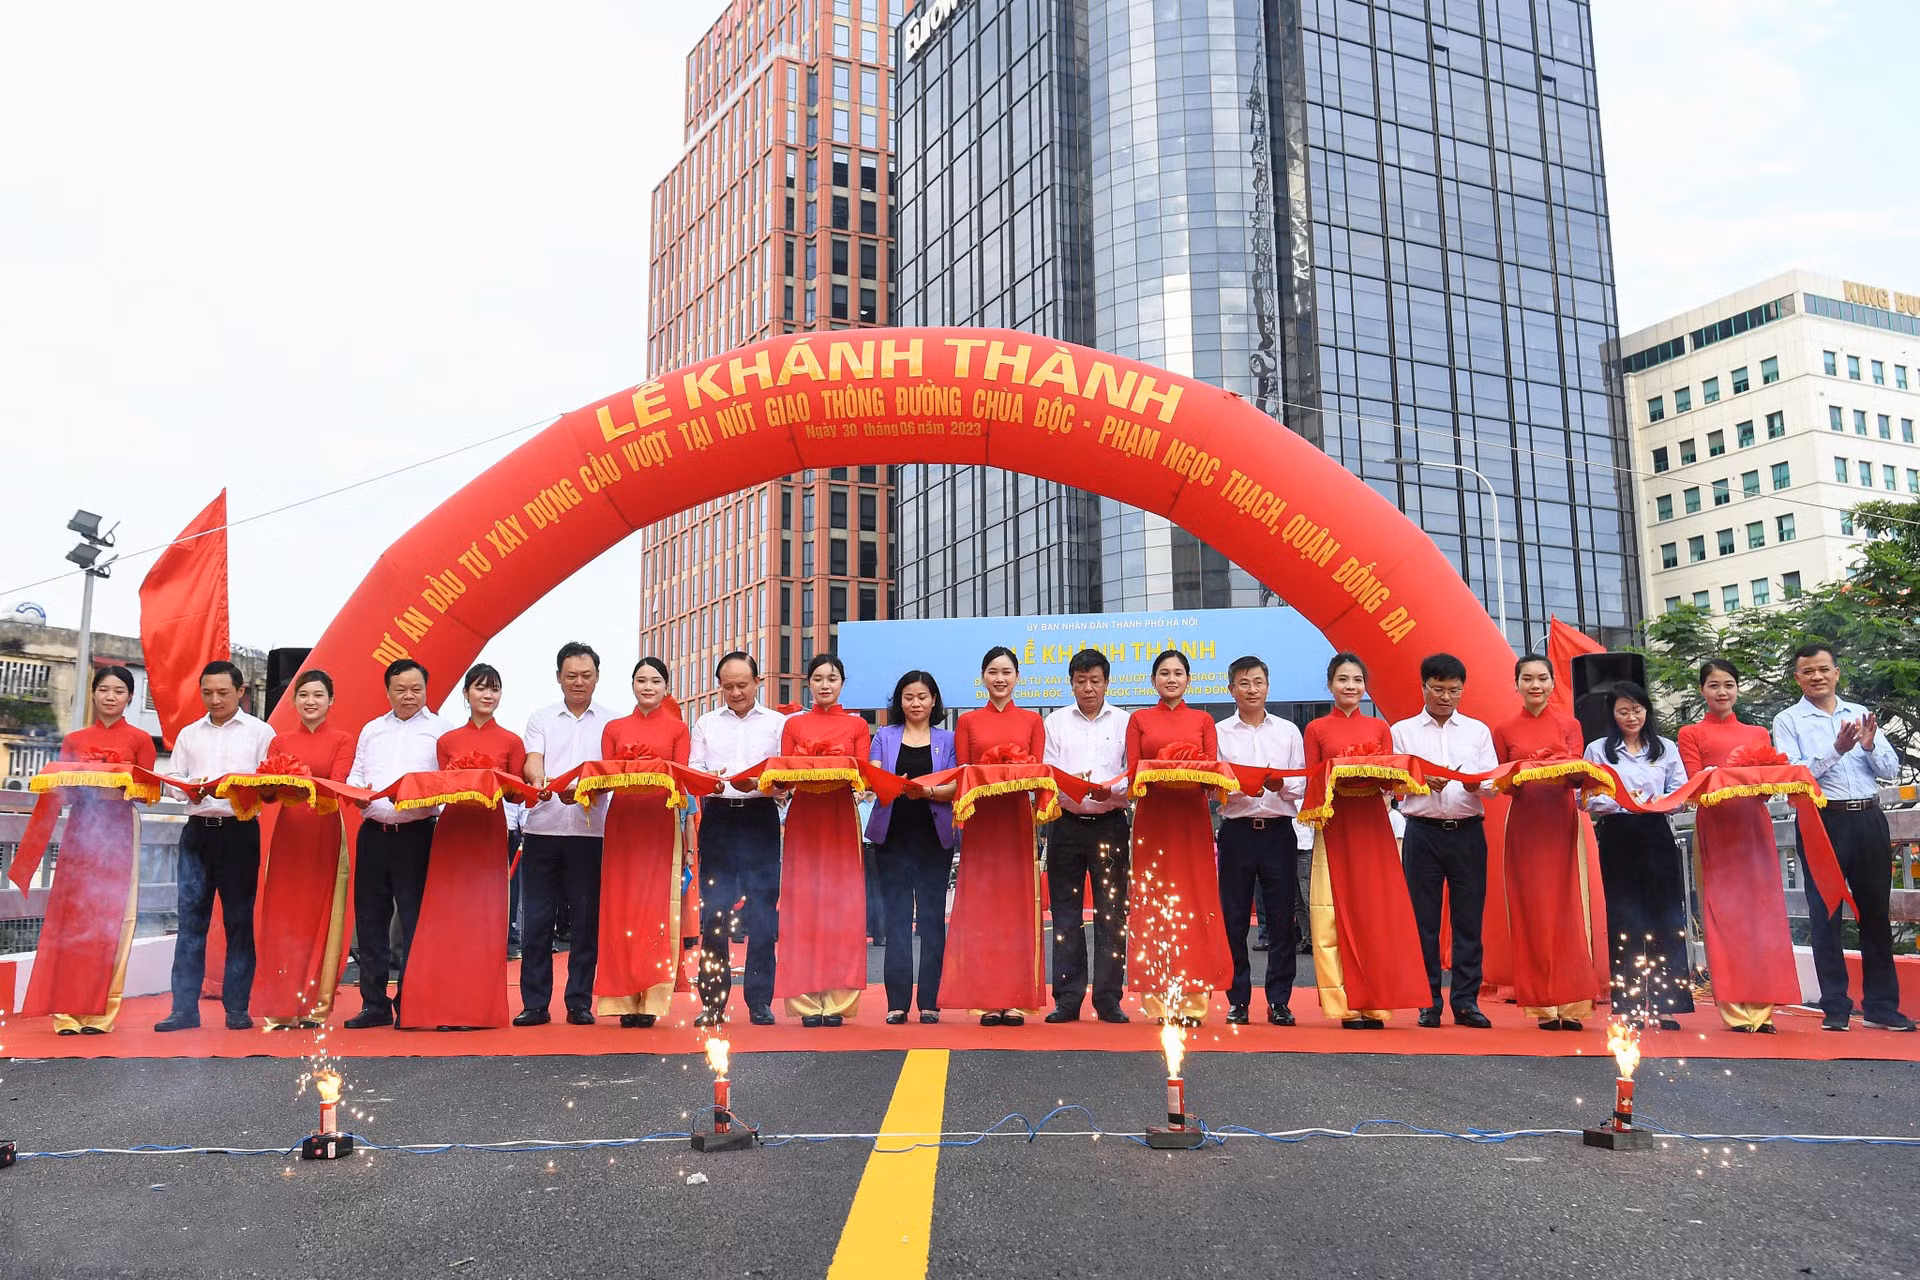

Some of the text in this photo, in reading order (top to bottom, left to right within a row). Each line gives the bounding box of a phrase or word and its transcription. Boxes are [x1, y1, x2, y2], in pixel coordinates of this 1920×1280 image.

[1843, 280, 1890, 310] KING
[596, 337, 1185, 443] LỄ KHÁNH THÀNH
[806, 420, 982, 439] Ngày 30 tháng 06 năm 2023
[394, 606, 434, 643] ÁN
[421, 569, 467, 614] ĐẦU
[457, 541, 492, 579] TƯ
[485, 514, 529, 559] XÂY
[523, 478, 583, 524] DỰNG
[578, 451, 622, 494] CẦU
[621, 429, 673, 472] VƯỢT
[678, 416, 714, 452] TẠI
[715, 401, 757, 439] NÚT
[765, 392, 811, 427] GIAO
[821, 383, 886, 420] THÔNG
[895, 379, 962, 417] ĐƯỜNG
[972, 387, 1024, 424] CHÙA
[1033, 396, 1077, 436] BỘC
[1098, 415, 1161, 460] PHẠM
[1161, 438, 1221, 487] NGỌC
[1220, 469, 1288, 536] THẠCH,
[1281, 513, 1342, 568] QUẬN
[1331, 556, 1392, 613] ĐỐNG
[1378, 606, 1418, 644] ĐA
[1042, 623, 1060, 631] BAN
